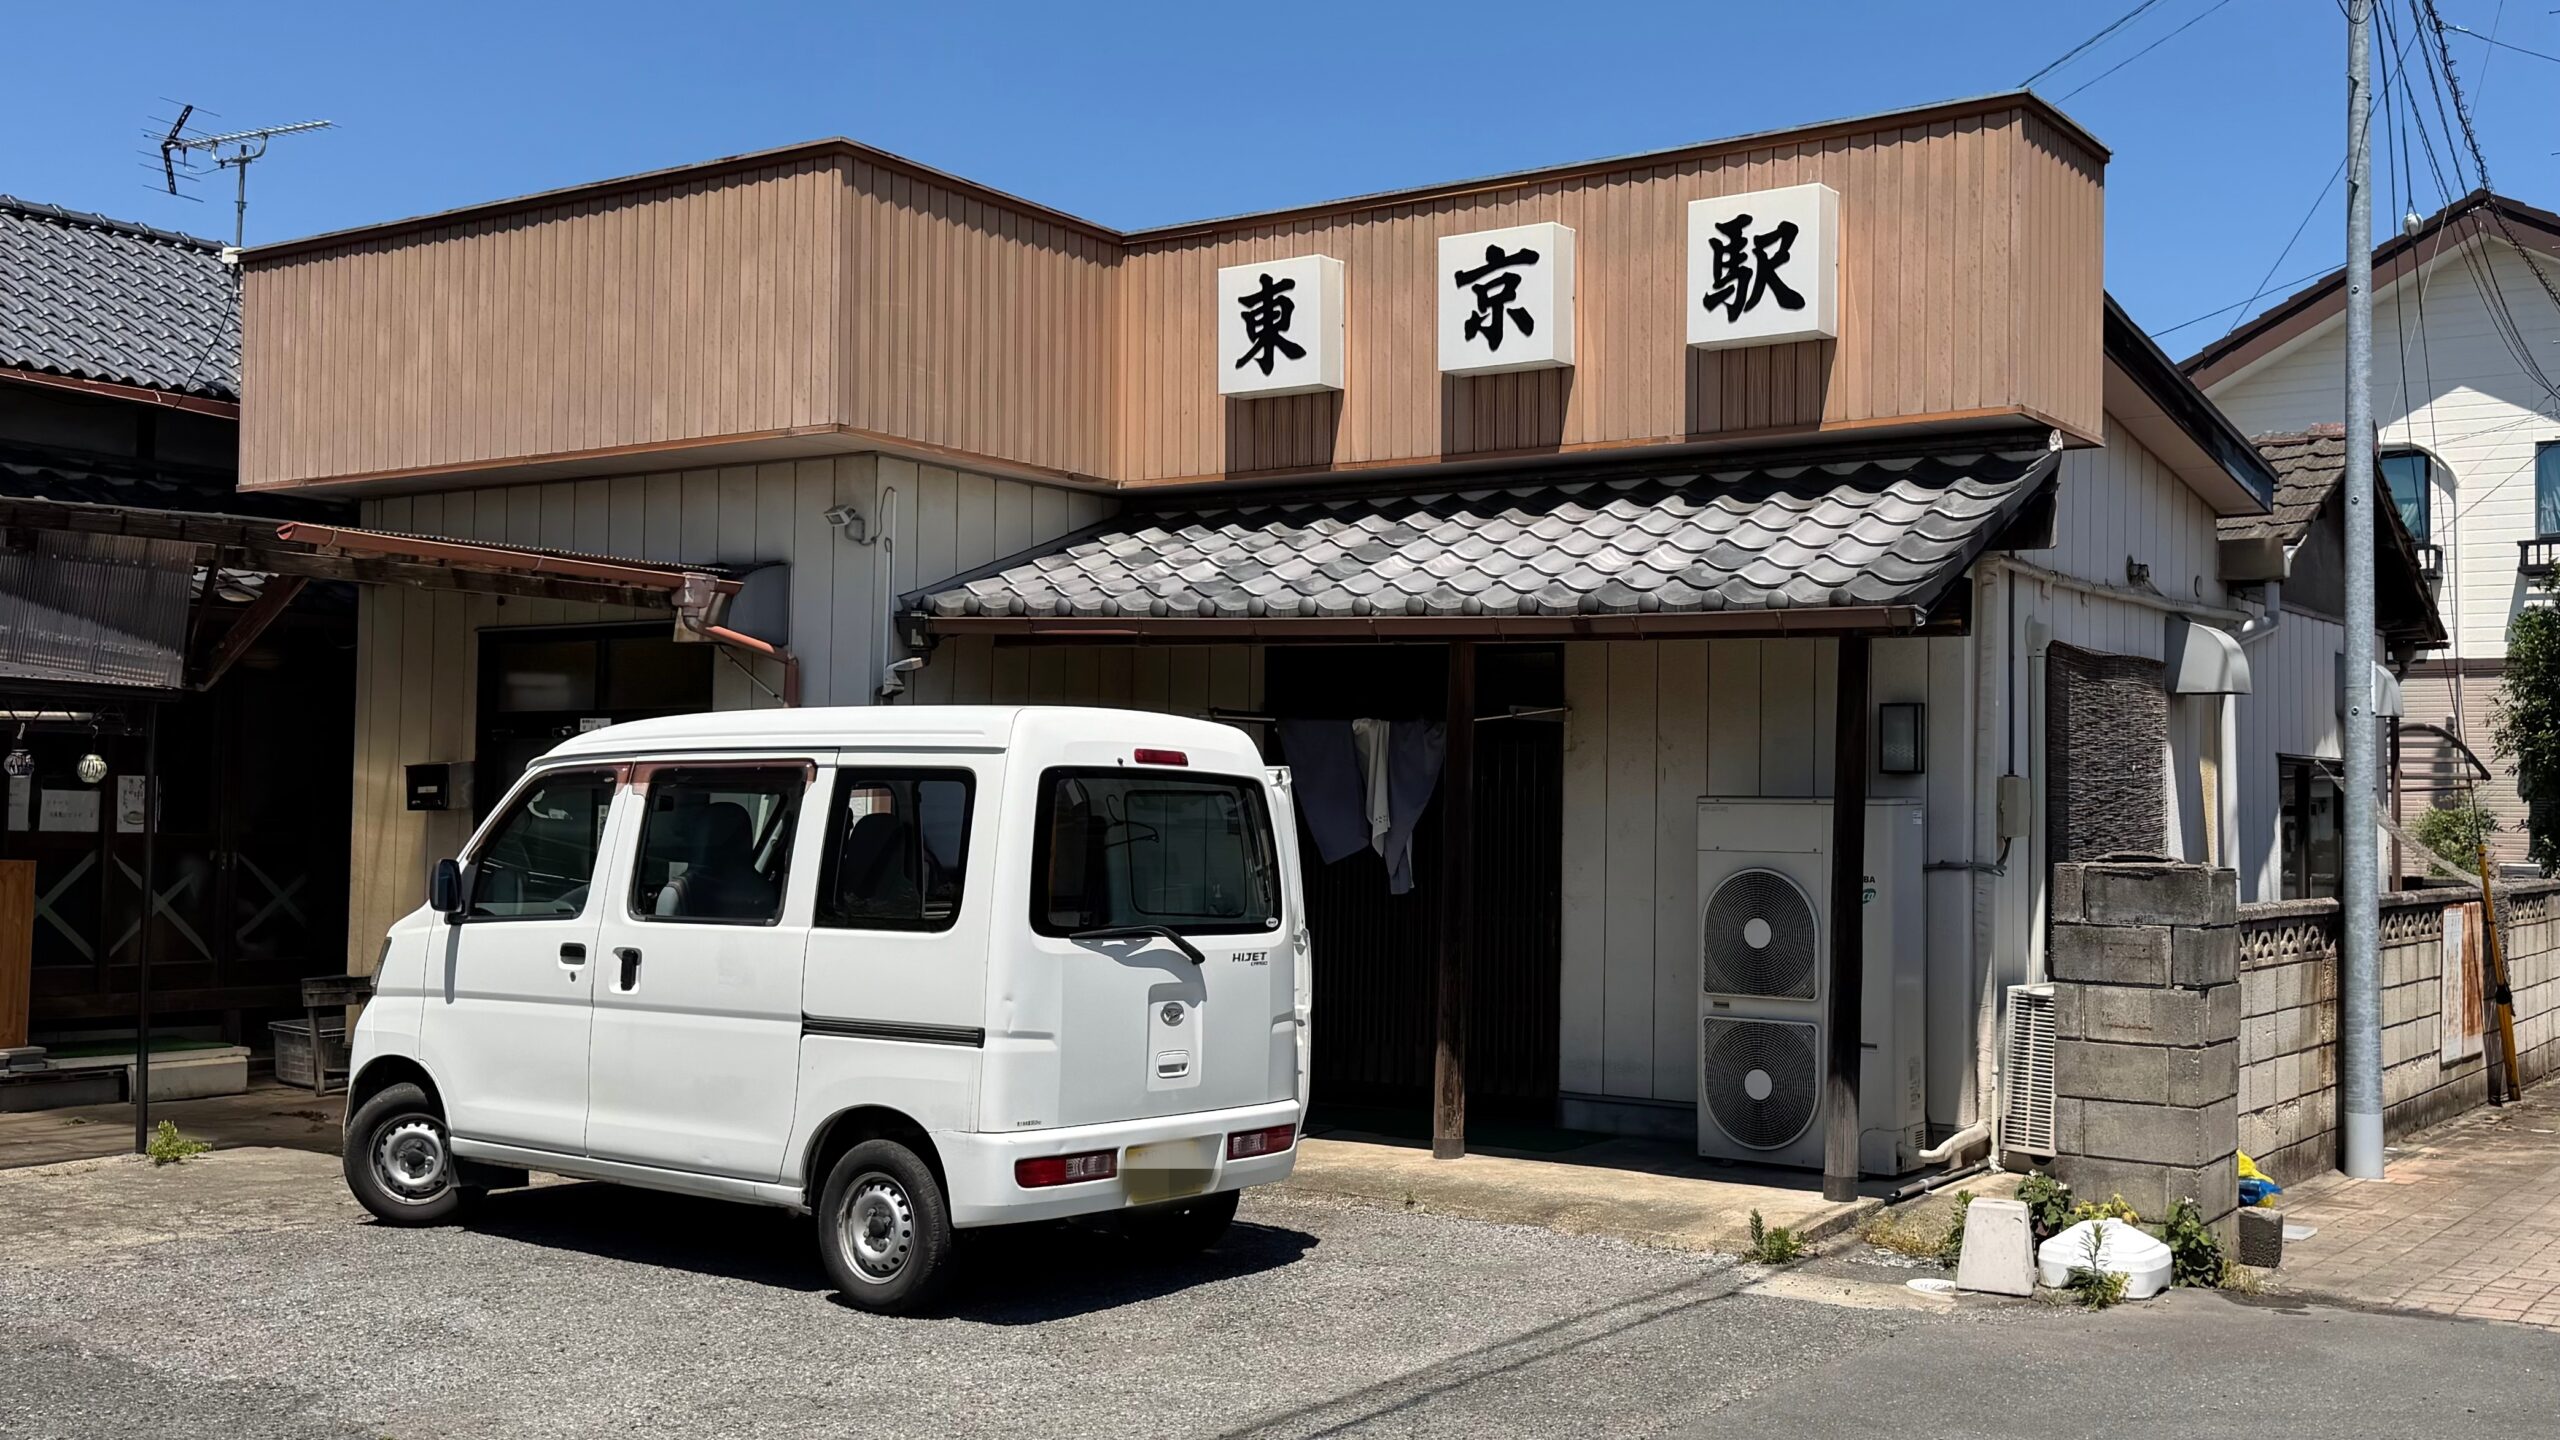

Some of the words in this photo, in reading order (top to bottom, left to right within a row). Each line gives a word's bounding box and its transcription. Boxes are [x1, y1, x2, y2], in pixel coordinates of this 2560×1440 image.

[1236, 213, 1806, 376] 東京駅
[1232, 951, 1268, 962] HIJET
